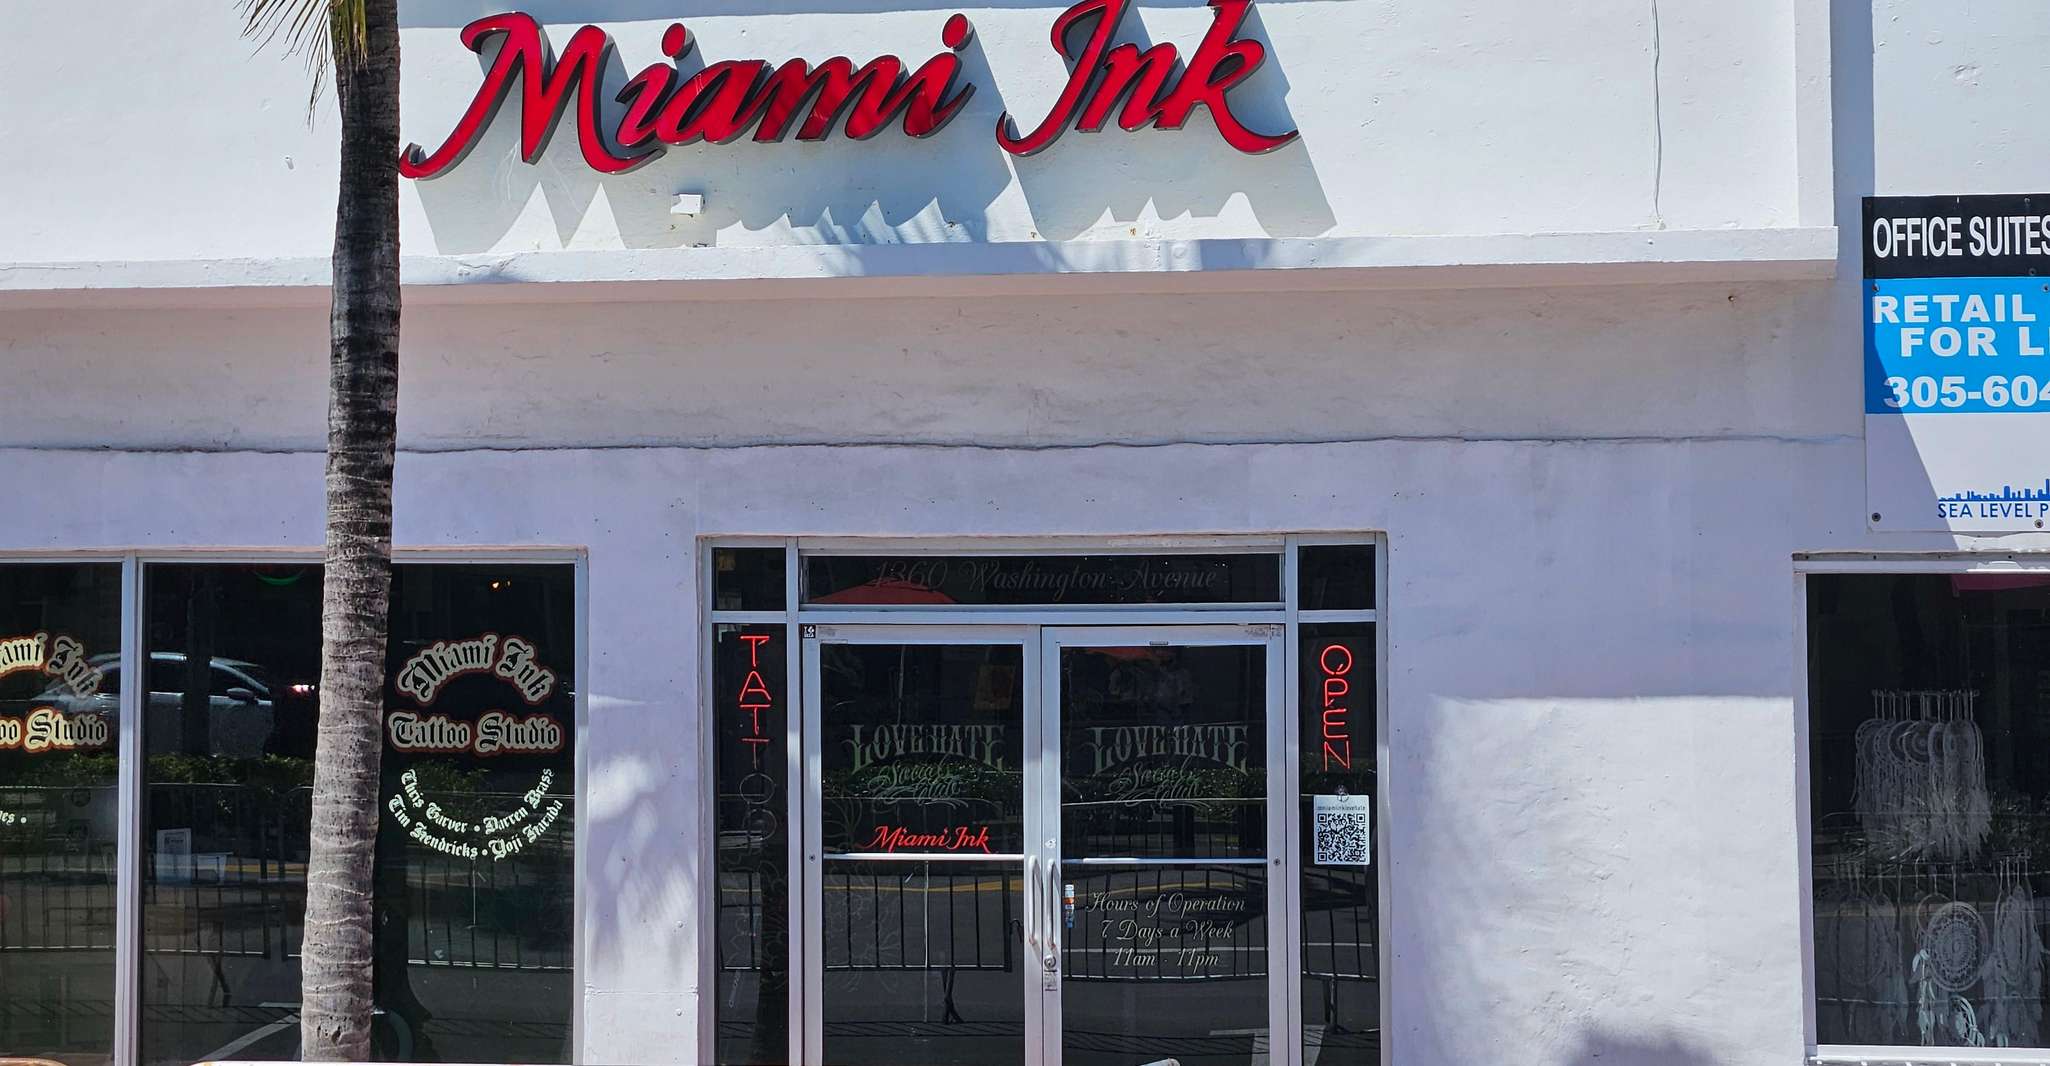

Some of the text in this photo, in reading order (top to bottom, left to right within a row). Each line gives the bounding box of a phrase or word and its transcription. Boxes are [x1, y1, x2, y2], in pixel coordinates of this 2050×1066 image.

[400, 0, 1300, 179] Miami Ink
[1873, 217, 1963, 258] OFFICE
[1872, 294, 2036, 323] RETAIL
[1901, 327, 1998, 357] FOR
[1938, 503, 1973, 518] SEA
[1980, 503, 2033, 518] LEVEL
[873, 560, 1217, 601] 1360 Washington Avenue
[48, 636, 103, 698] Ink
[398, 634, 555, 702] Miami Ink
[1321, 643, 1353, 773] OPEN
[25, 709, 108, 750] Studio
[388, 711, 561, 752] Tattoo Studio
[738, 635, 776, 840] TATTOO
[401, 768, 554, 834] Chris Garver Darren Brass
[388, 793, 563, 862] Tim Hendricks Yoji Harada
[862, 825, 993, 853] Miami Ink
[1086, 892, 1138, 913] Hours
[1145, 894, 1166, 918] of
[1168, 893, 1246, 919] Operation
[1101, 920, 1233, 946] 7 Days a Week
[1113, 947, 1155, 966] 11am
[1177, 948, 1220, 974] 11pm
